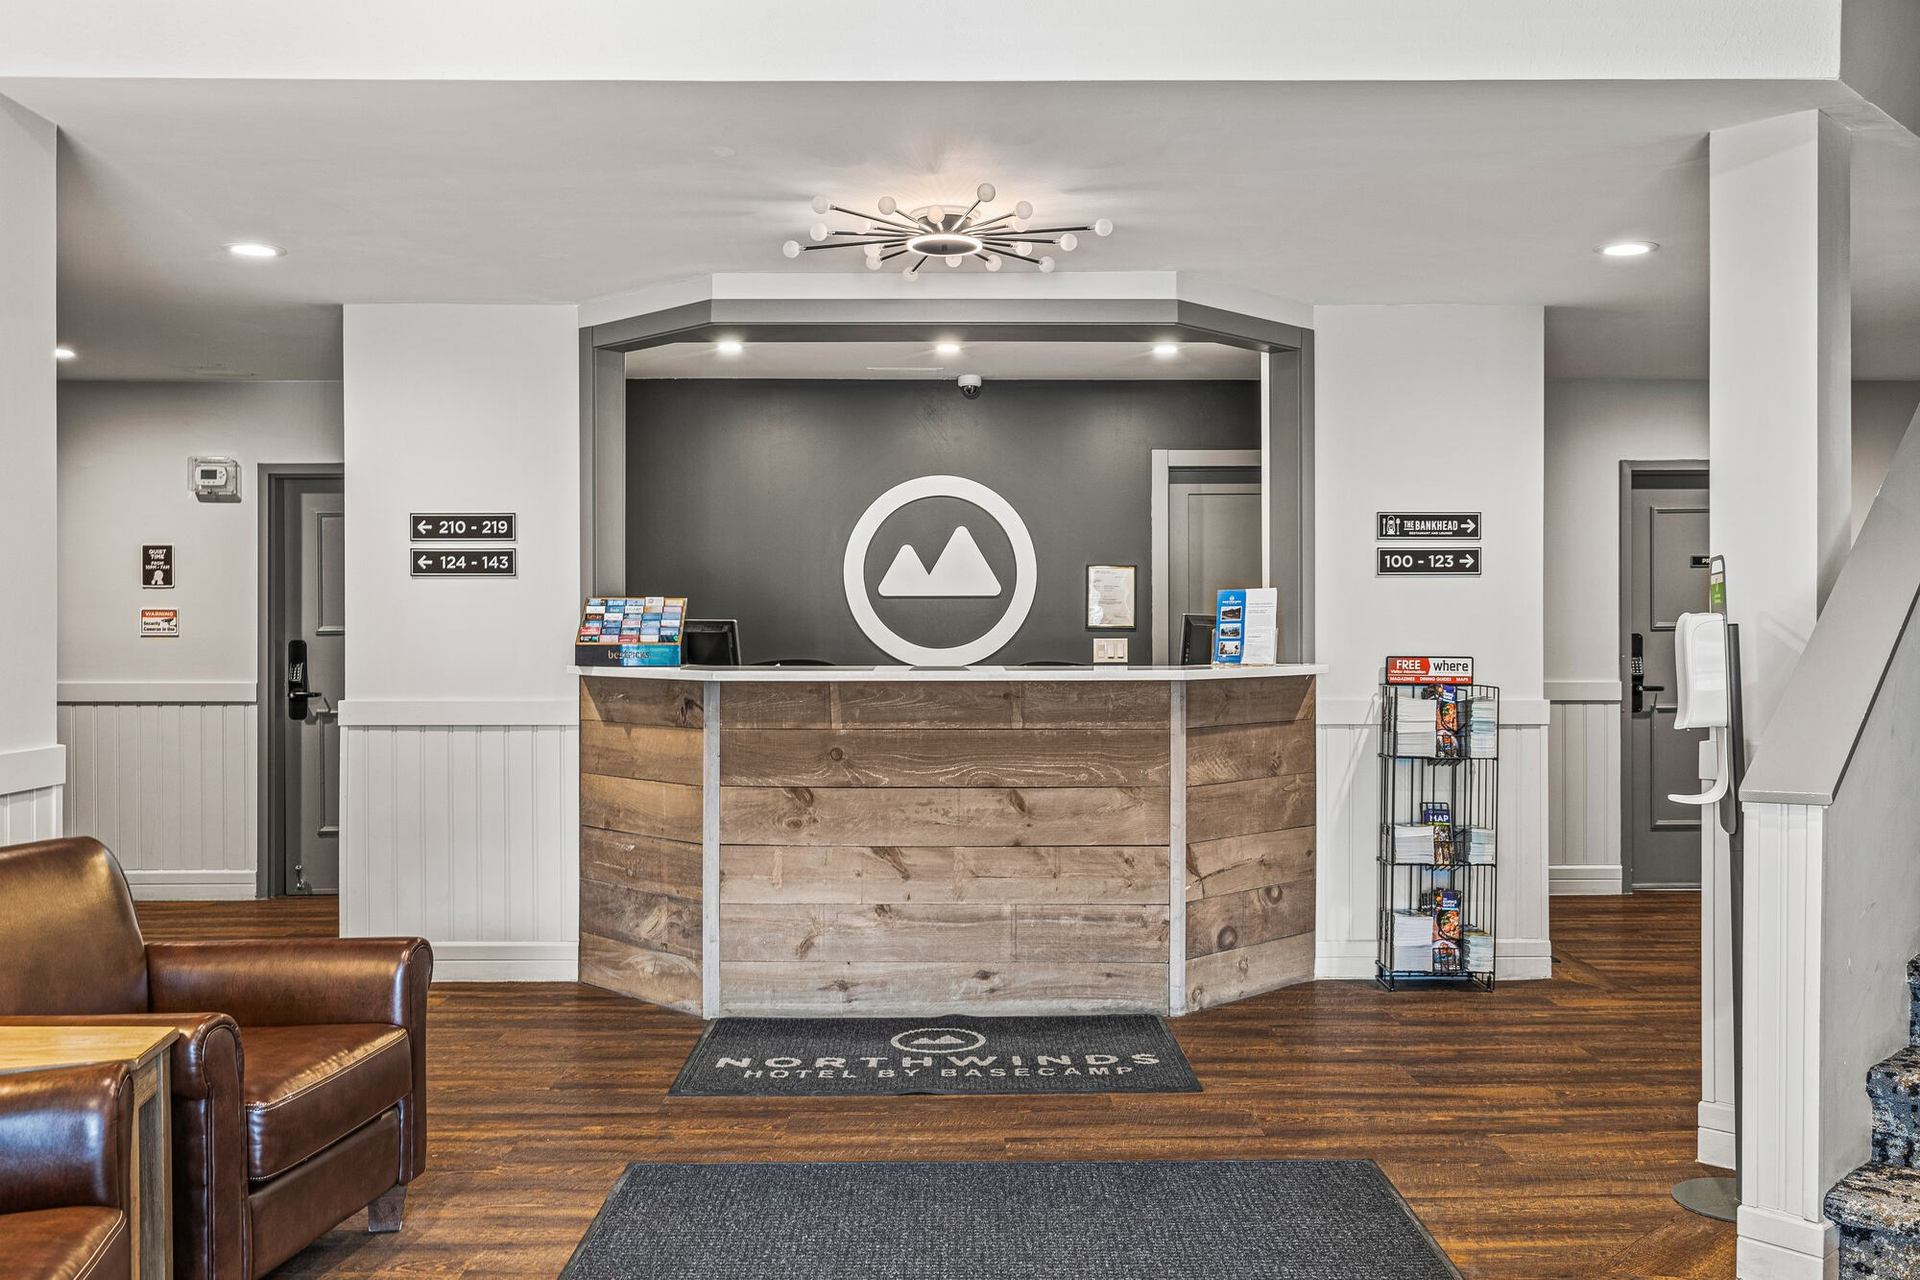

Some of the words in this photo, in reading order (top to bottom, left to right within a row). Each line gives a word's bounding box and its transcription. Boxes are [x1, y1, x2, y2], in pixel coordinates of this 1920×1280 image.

[439, 520, 466, 534] 210
[482, 520, 508, 534] 219
[1403, 520, 1415, 530] THE
[1415, 520, 1458, 531] BANKHEAD
[440, 556, 467, 569] 124
[482, 556, 509, 569] 143
[1384, 555, 1413, 568] 100
[1428, 555, 1454, 568] 123
[1396, 659, 1421, 670] FREE
[1433, 660, 1469, 672] where
[715, 1053, 1160, 1068] NORTHWINDS
[743, 1069, 856, 1078] HOTEL
[877, 1068, 920, 1078] BY
[940, 1066, 1133, 1077] BASECAMP
